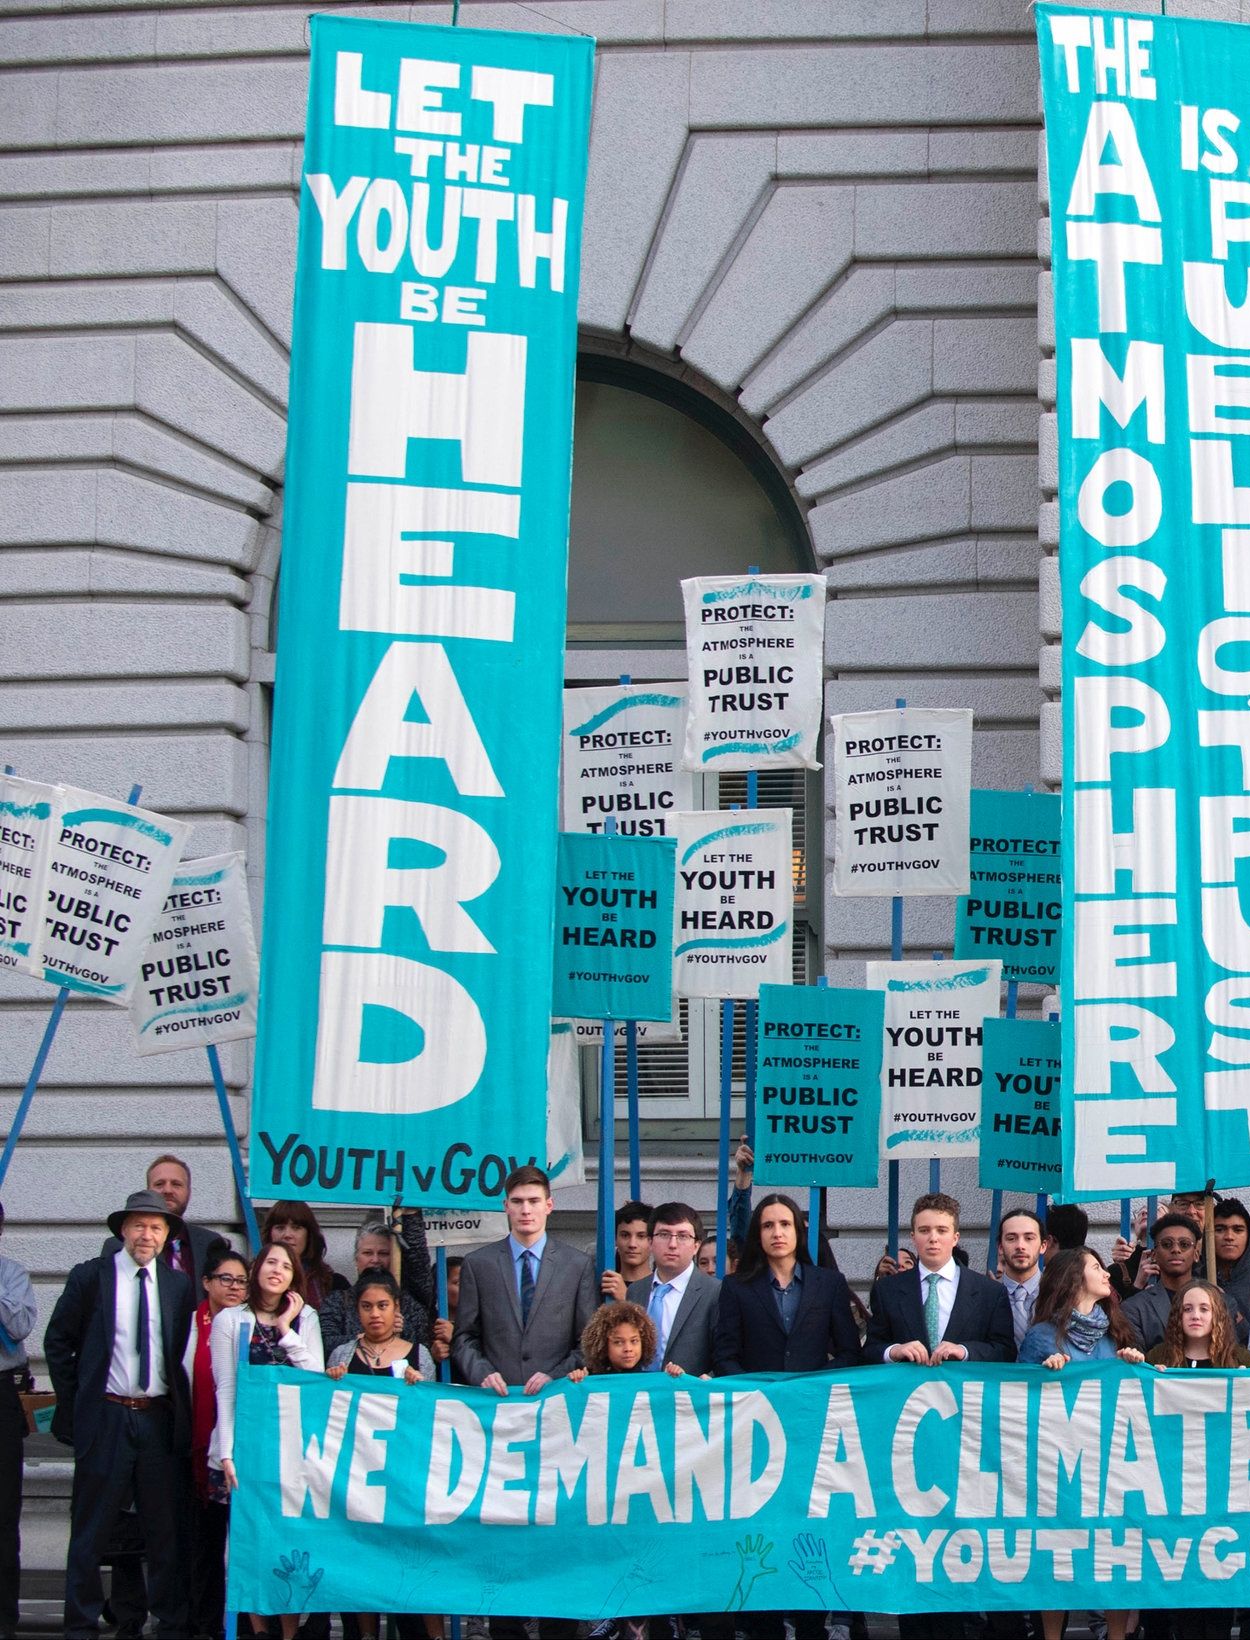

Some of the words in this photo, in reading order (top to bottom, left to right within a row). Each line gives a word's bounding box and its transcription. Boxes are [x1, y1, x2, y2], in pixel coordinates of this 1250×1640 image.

[1050, 14, 1157, 101] THE
[335, 51, 554, 144] LET
[1180, 105, 1240, 174] IS
[394, 137, 511, 186] THE
[305, 173, 569, 293] YOUTH
[400, 281, 487, 326] BE
[701, 604, 794, 622] PROTECT:
[702, 638, 794, 652] ATMOSPHERE
[1066, 101, 1177, 1191] ATMOSPHERE
[703, 666, 794, 688] PUBLIC
[708, 693, 789, 713] TRUST
[312, 322, 528, 1115] HEARD
[579, 730, 673, 749] PROTECT:
[845, 734, 942, 755] PROTECT:
[580, 763, 673, 779] ATMOSPHERE
[847, 768, 942, 785] ATMOSPHERE
[582, 791, 674, 814] PUBLIC
[849, 796, 943, 821] PUBLIC
[854, 823, 939, 846] TRUST
[59, 829, 152, 872] PROTECT:
[971, 838, 1061, 854] PROTECT
[94, 861, 109, 871] THE
[704, 854, 726, 863] LET
[729, 854, 753, 863] THE
[51, 862, 142, 899] ATMOSPHERE
[585, 870, 607, 880] LET
[611, 871, 635, 881] THE
[680, 870, 775, 890] YOUTH
[562, 886, 657, 909] YOUTH
[720, 895, 736, 904] BE
[602, 913, 618, 922] BE
[681, 910, 774, 930] HEARD
[967, 900, 1061, 920] PUBLIC
[152, 920, 226, 943] MOSPHERE
[563, 927, 657, 949] HEARD
[970, 927, 1057, 947] TRUST
[141, 948, 231, 982] PUBLIC
[149, 975, 231, 1006] TRUST
[909, 1010, 932, 1019] LET
[935, 1010, 960, 1019] THE
[764, 1022, 861, 1039] PROTECT:
[886, 1027, 983, 1047] YOUTH
[762, 1056, 860, 1069] ATMOSPHERE
[927, 1052, 943, 1061] BE
[1019, 1057, 1042, 1067] LET
[888, 1067, 983, 1088] HEARD
[763, 1086, 859, 1107] PUBLIC
[1034, 1101, 1050, 1110] BE
[767, 1115, 853, 1135] TRUST
[277, 1383, 398, 1523] WE
[425, 1389, 787, 1525] DEMAND
[807, 1383, 877, 1519] A
